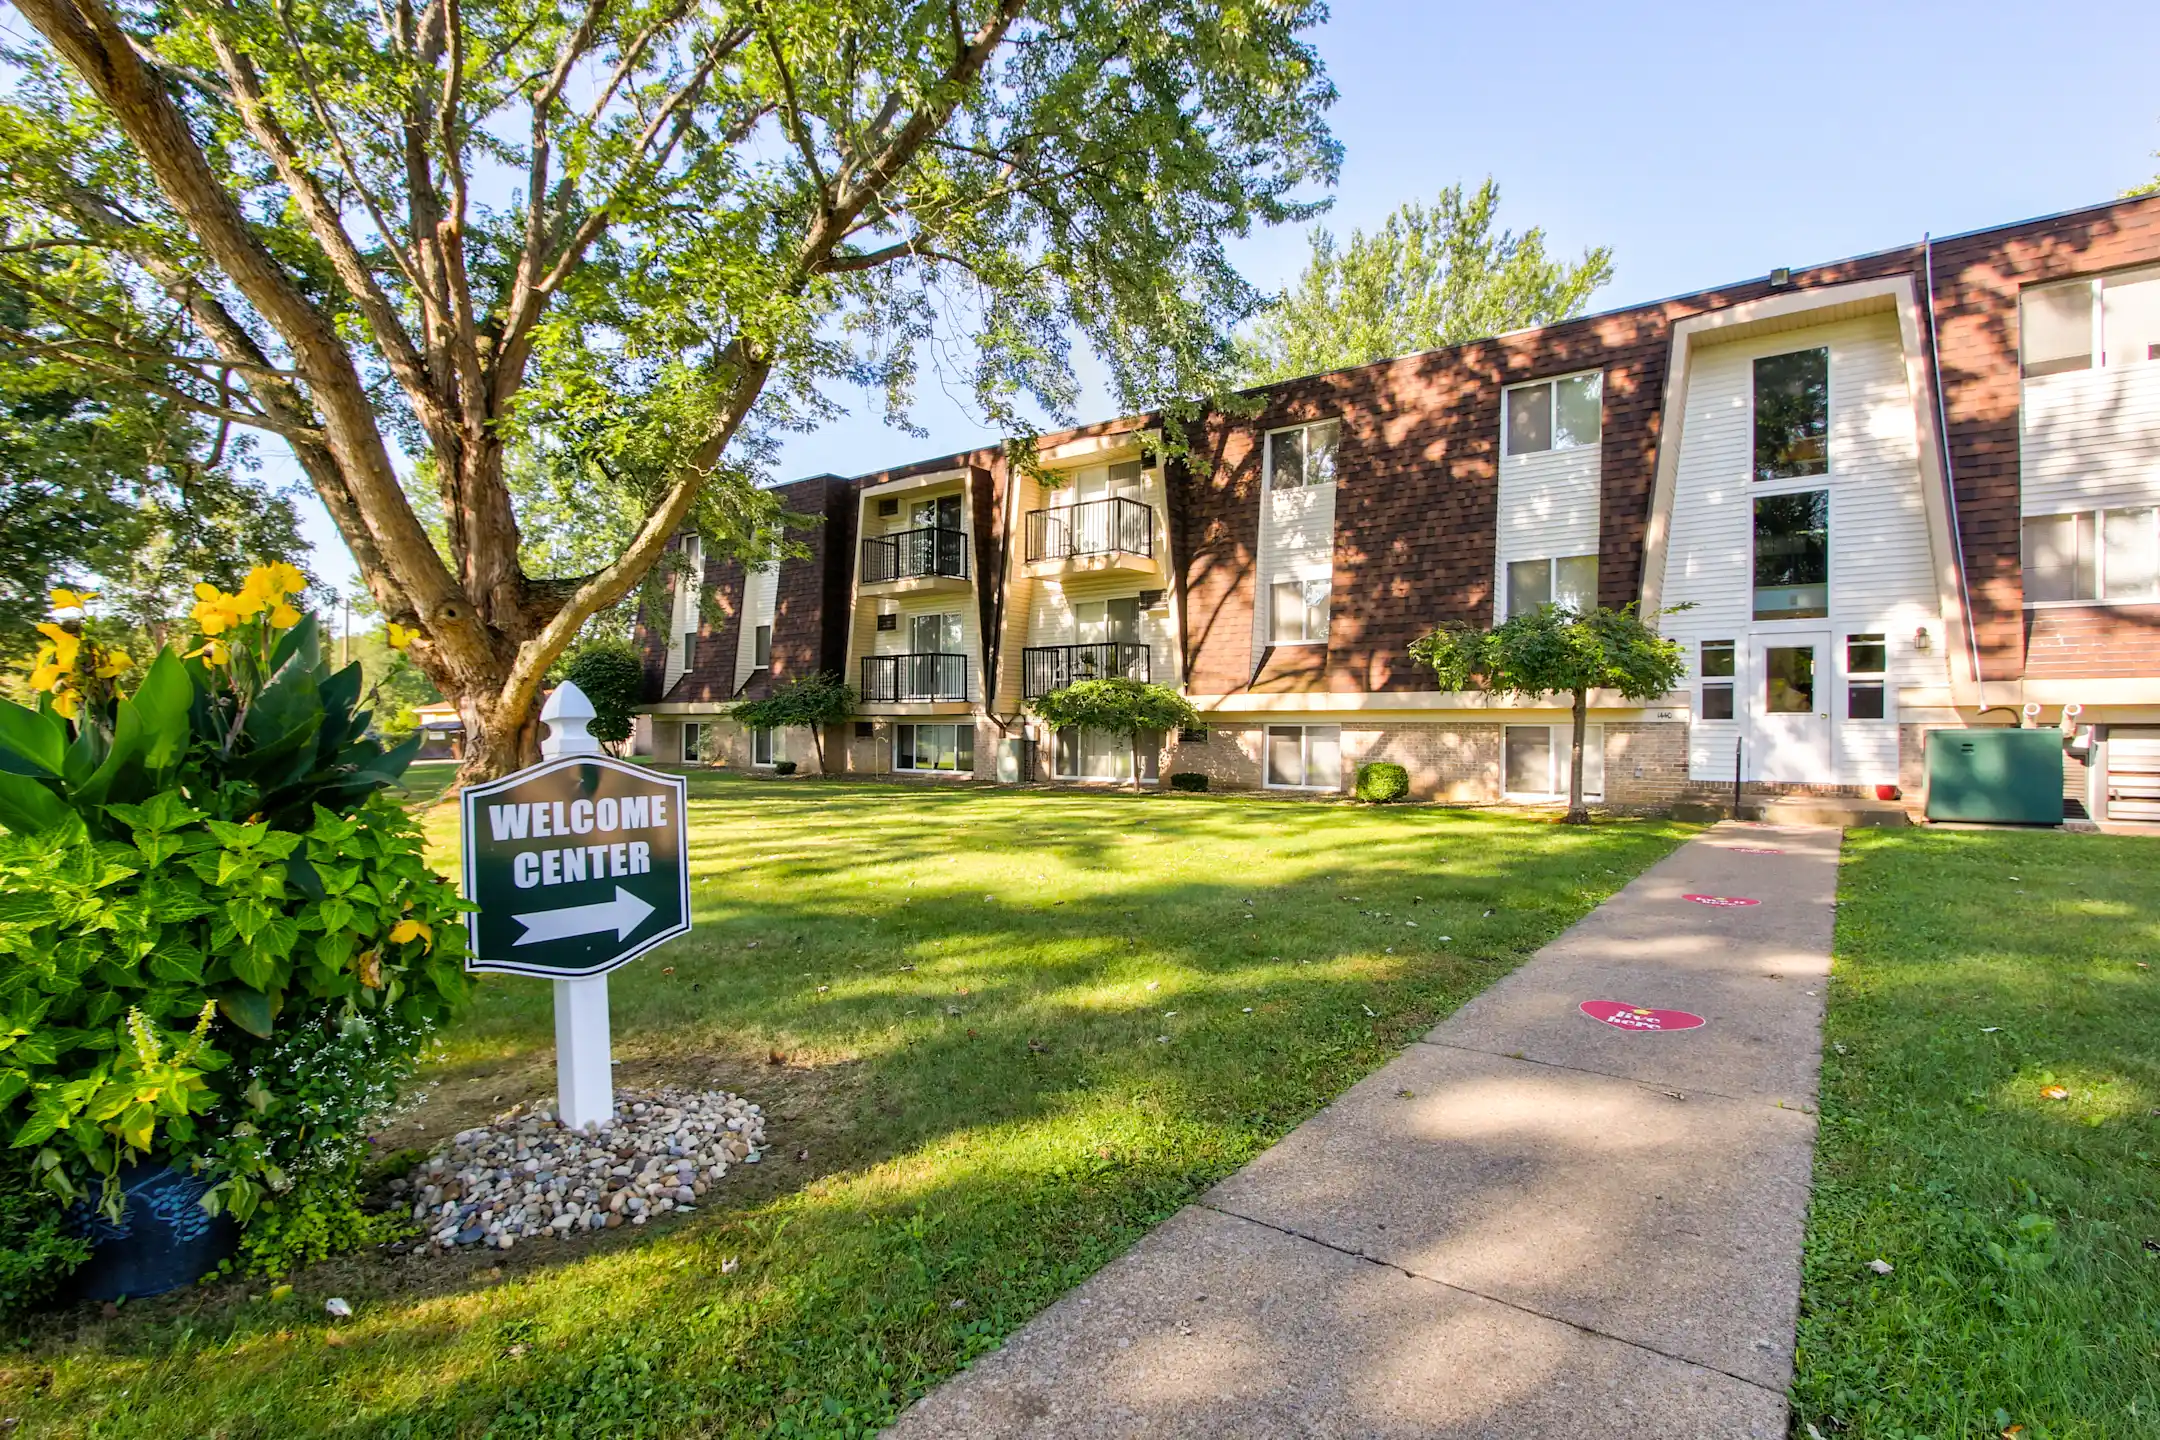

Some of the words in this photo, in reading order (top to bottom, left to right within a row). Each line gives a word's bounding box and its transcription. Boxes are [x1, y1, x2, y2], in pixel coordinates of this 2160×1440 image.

[489, 795, 667, 841] WELCOME
[513, 841, 651, 889] CENTER
[1607, 1015, 1661, 1029] here
[1616, 1011, 1660, 1023] live
